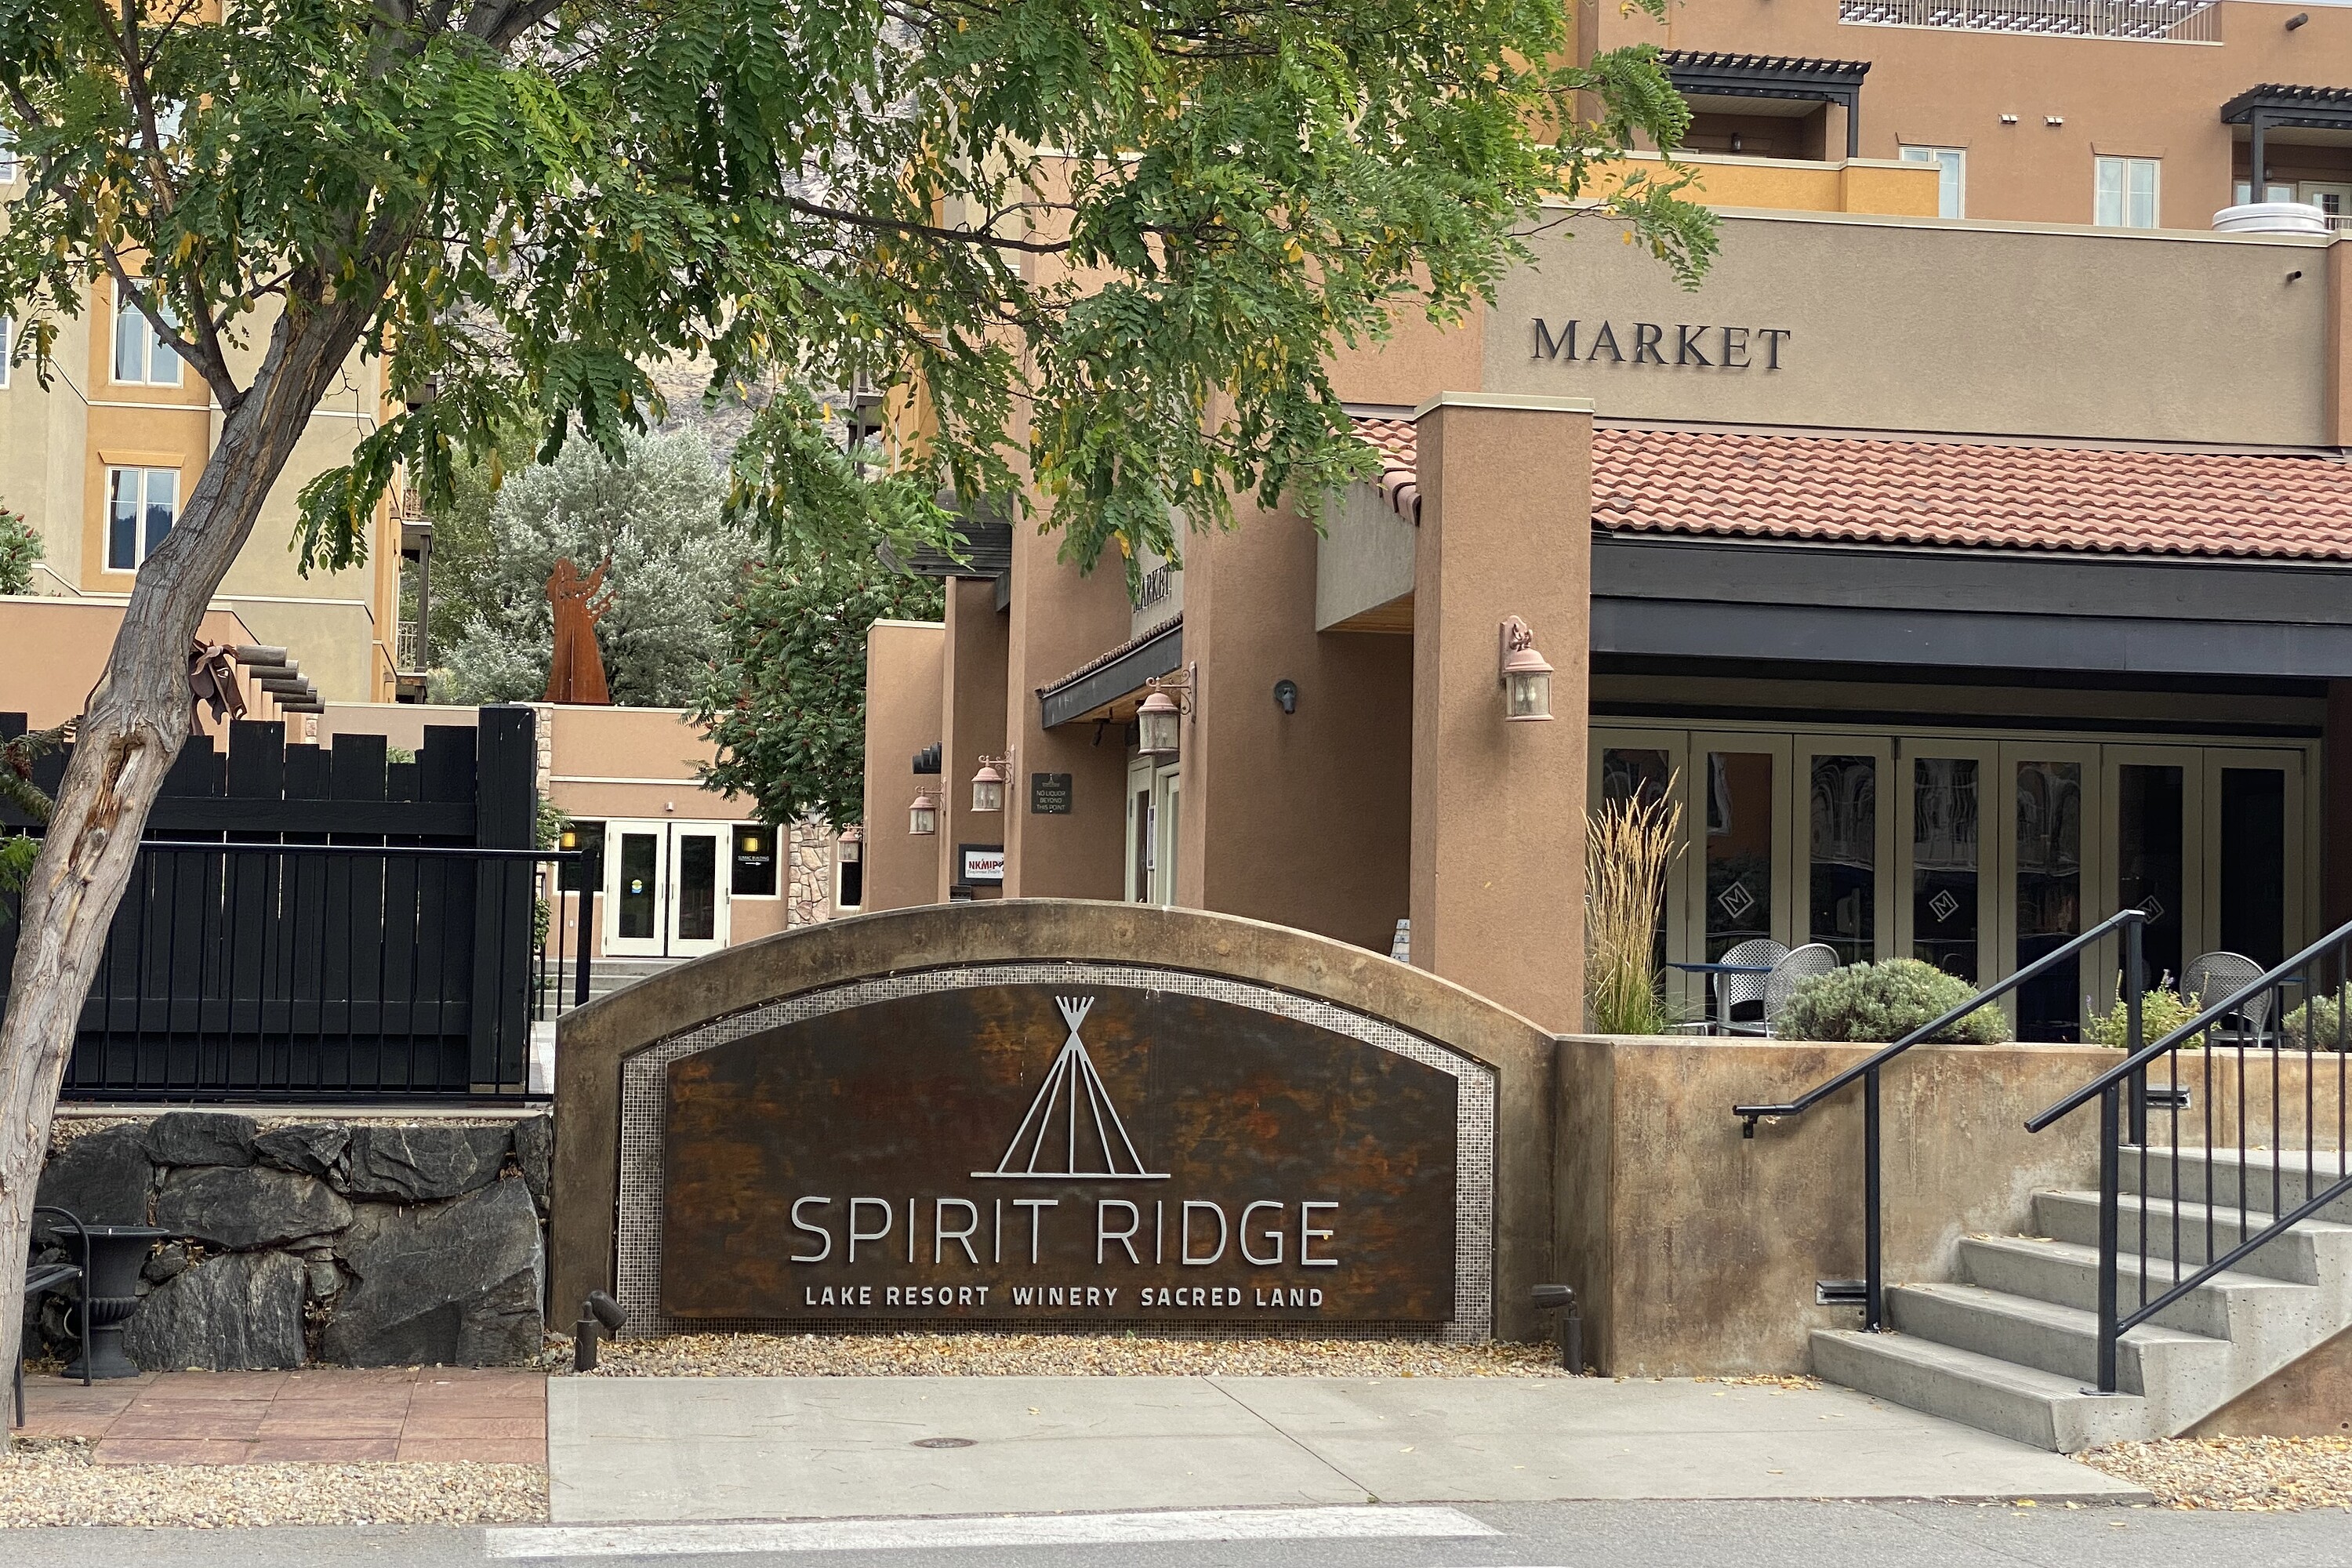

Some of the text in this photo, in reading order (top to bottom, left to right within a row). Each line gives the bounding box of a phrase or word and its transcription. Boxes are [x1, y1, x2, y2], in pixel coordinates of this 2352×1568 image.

[1530, 318, 1791, 370] MARKET
[790, 1196, 1339, 1265] SPIRIT RIDGE
[805, 1286, 1323, 1307] LAKE RESORT WINERY SACRED LAND
